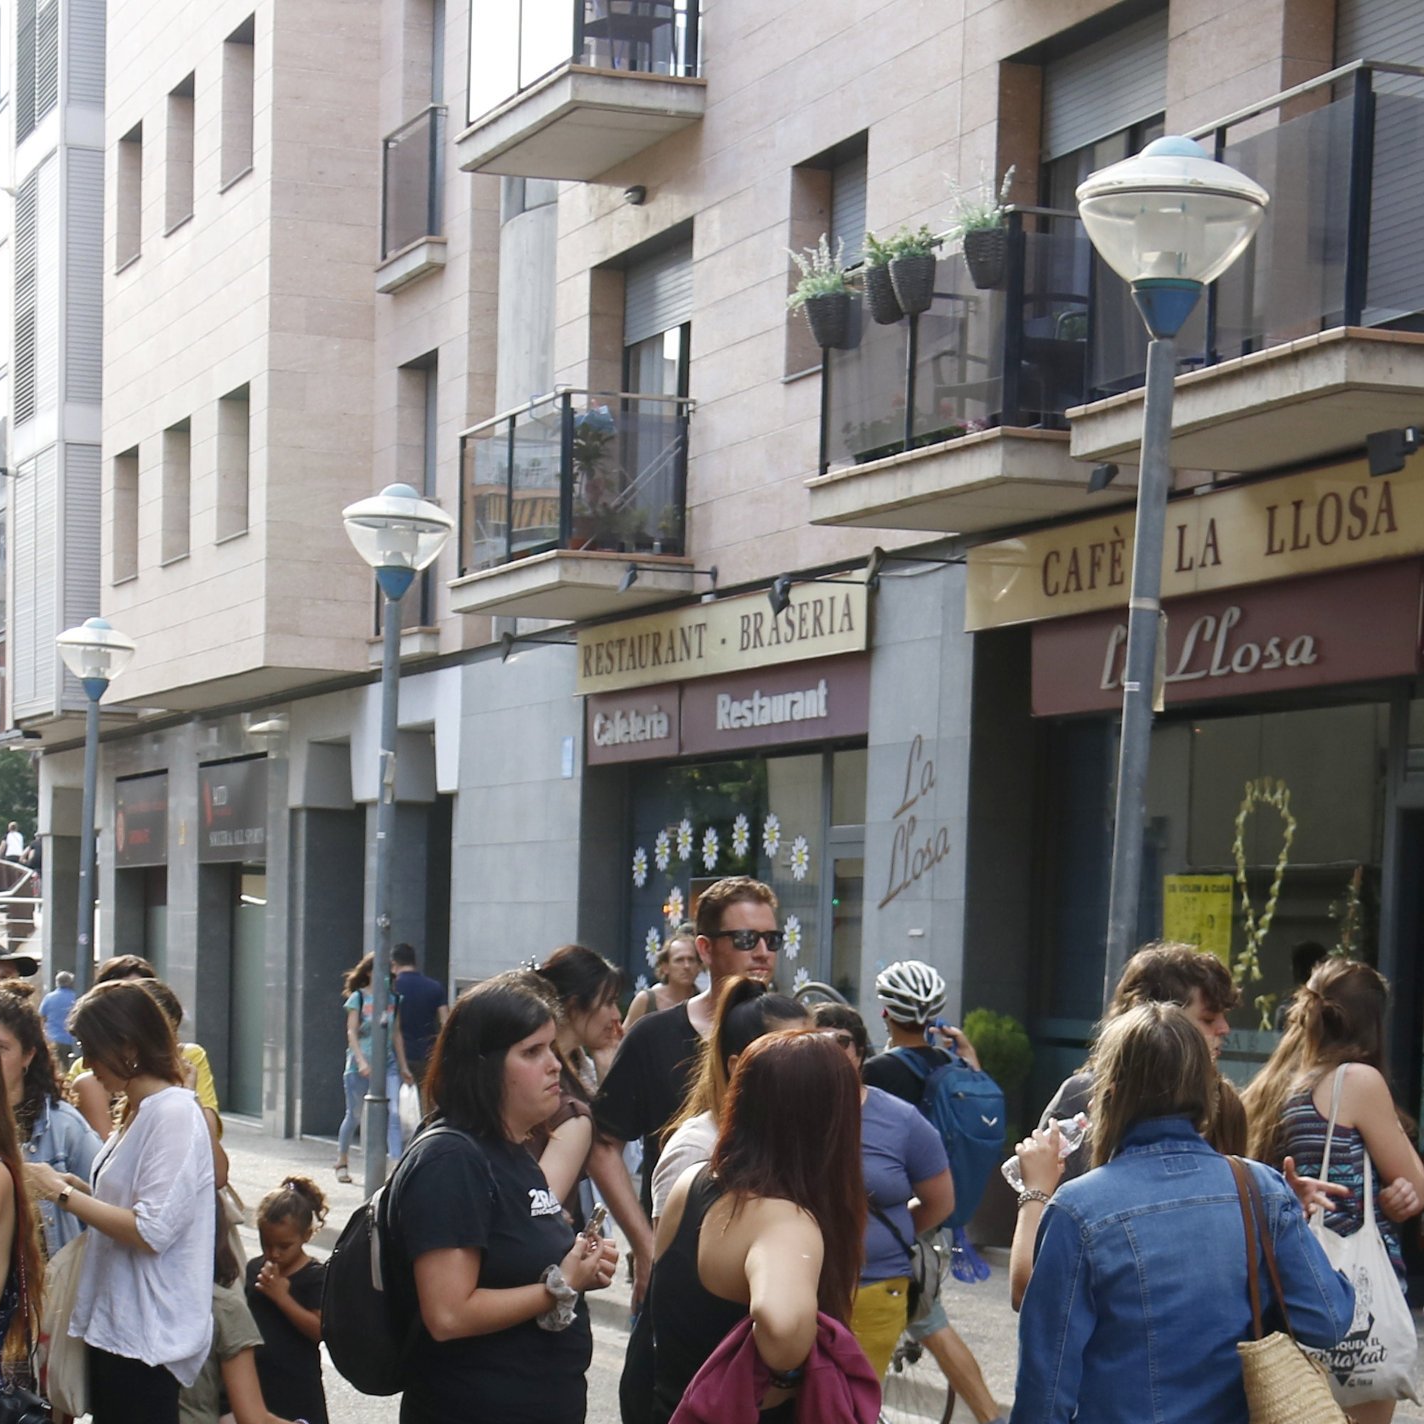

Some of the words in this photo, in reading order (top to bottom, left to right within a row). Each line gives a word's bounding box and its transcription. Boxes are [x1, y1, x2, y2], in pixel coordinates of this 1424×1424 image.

[1042, 526, 1126, 597] CAFÈ
[1174, 517, 1223, 574] LA
[1264, 480, 1398, 556] LLOSA
[582, 622, 708, 679] RESTAURANT
[739, 592, 855, 652] BRASERIA
[1162, 605, 1319, 684] Llosa
[592, 704, 670, 748] Cafeteria
[716, 678, 829, 731] Restaurant
[892, 733, 936, 820] La
[878, 815, 951, 910] Llosa
